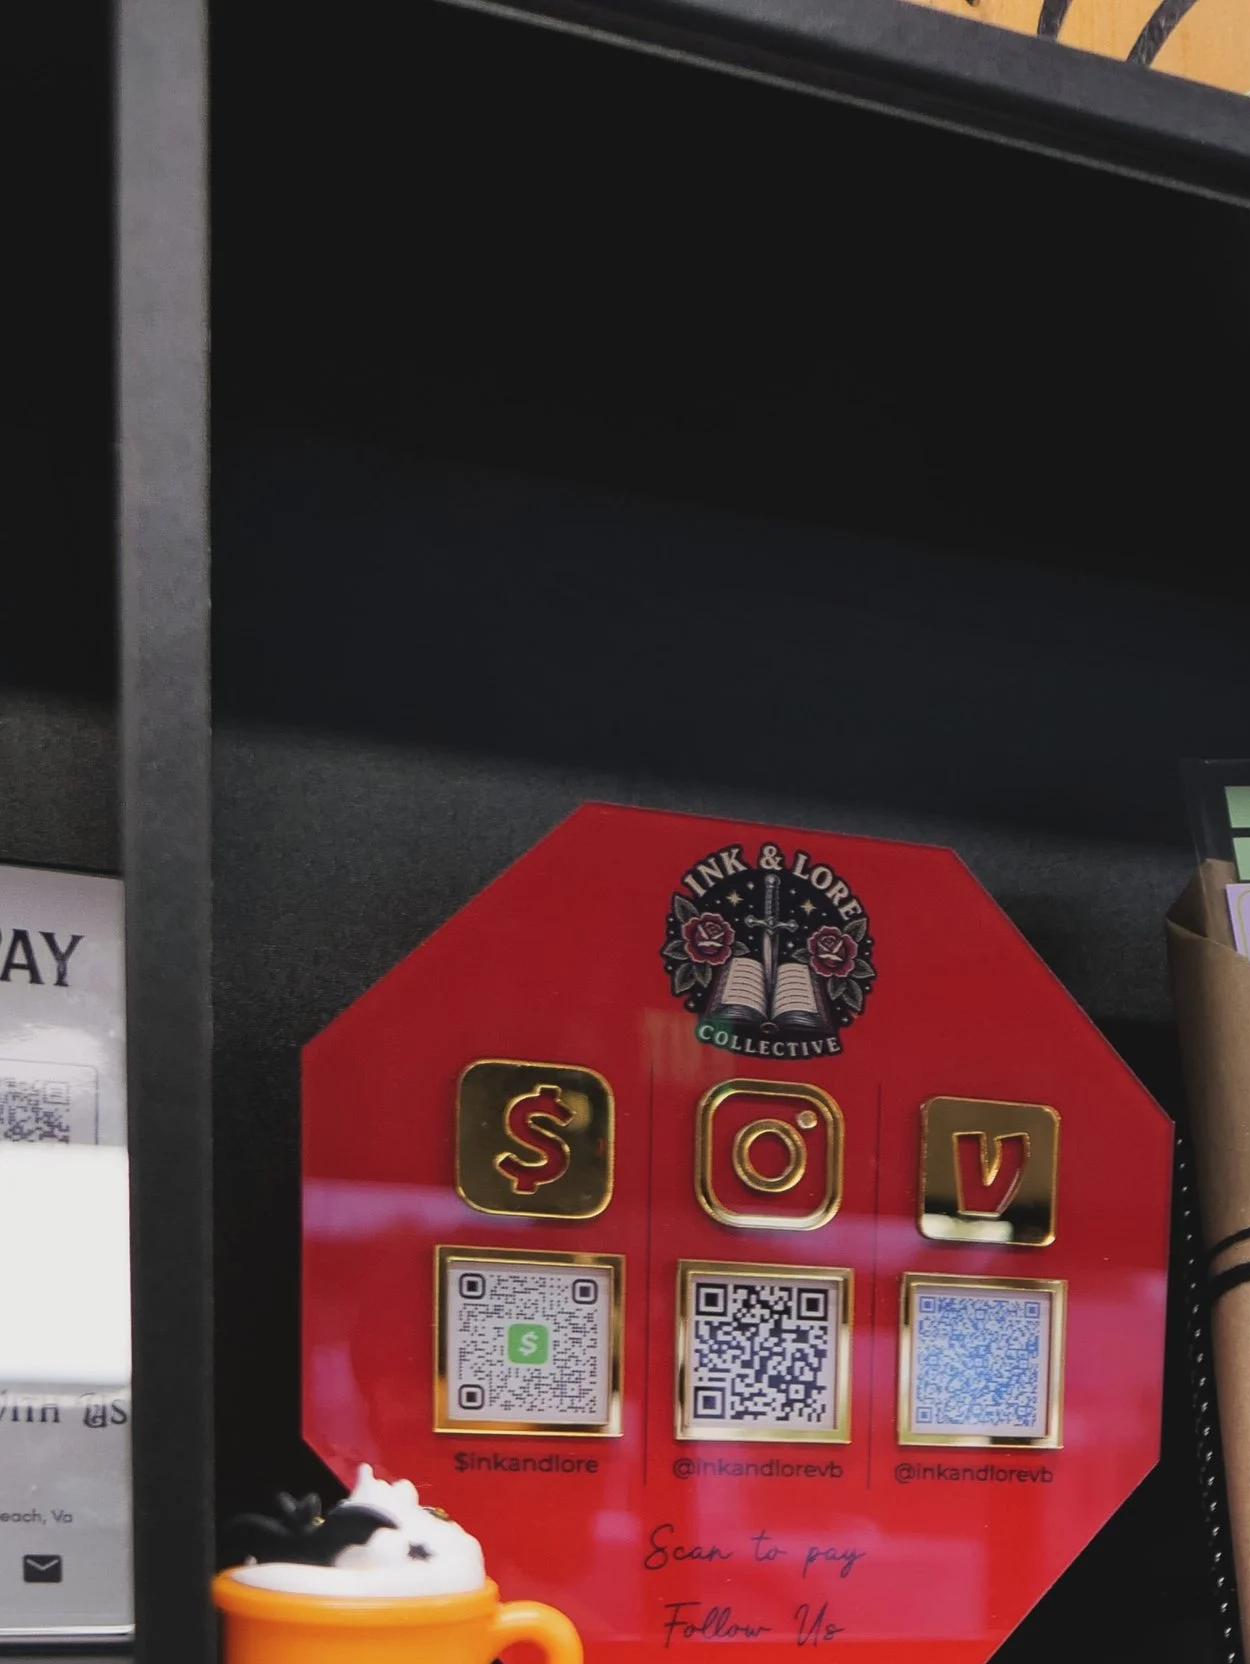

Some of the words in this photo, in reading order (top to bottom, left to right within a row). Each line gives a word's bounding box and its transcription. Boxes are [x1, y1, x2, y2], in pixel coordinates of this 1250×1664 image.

[684, 847, 748, 898] INK
[759, 845, 783, 872] &
[792, 853, 863, 921] LORE
[0, 928, 85, 988] AY
[698, 1024, 841, 1057] COLLECTIVE
[454, 1452, 599, 1475] $inkandlore
[673, 1457, 844, 1482] @inkandlorevb
[894, 1462, 1054, 1485] @inkandlorevb
[0, 1507, 47, 1525] each,
[52, 1508, 73, 1524] Va
[644, 1523, 733, 1572] Scan
[750, 1528, 790, 1565] to
[800, 1542, 867, 1577] pay
[660, 1601, 773, 1649] Follow
[791, 1603, 846, 1649] Us
